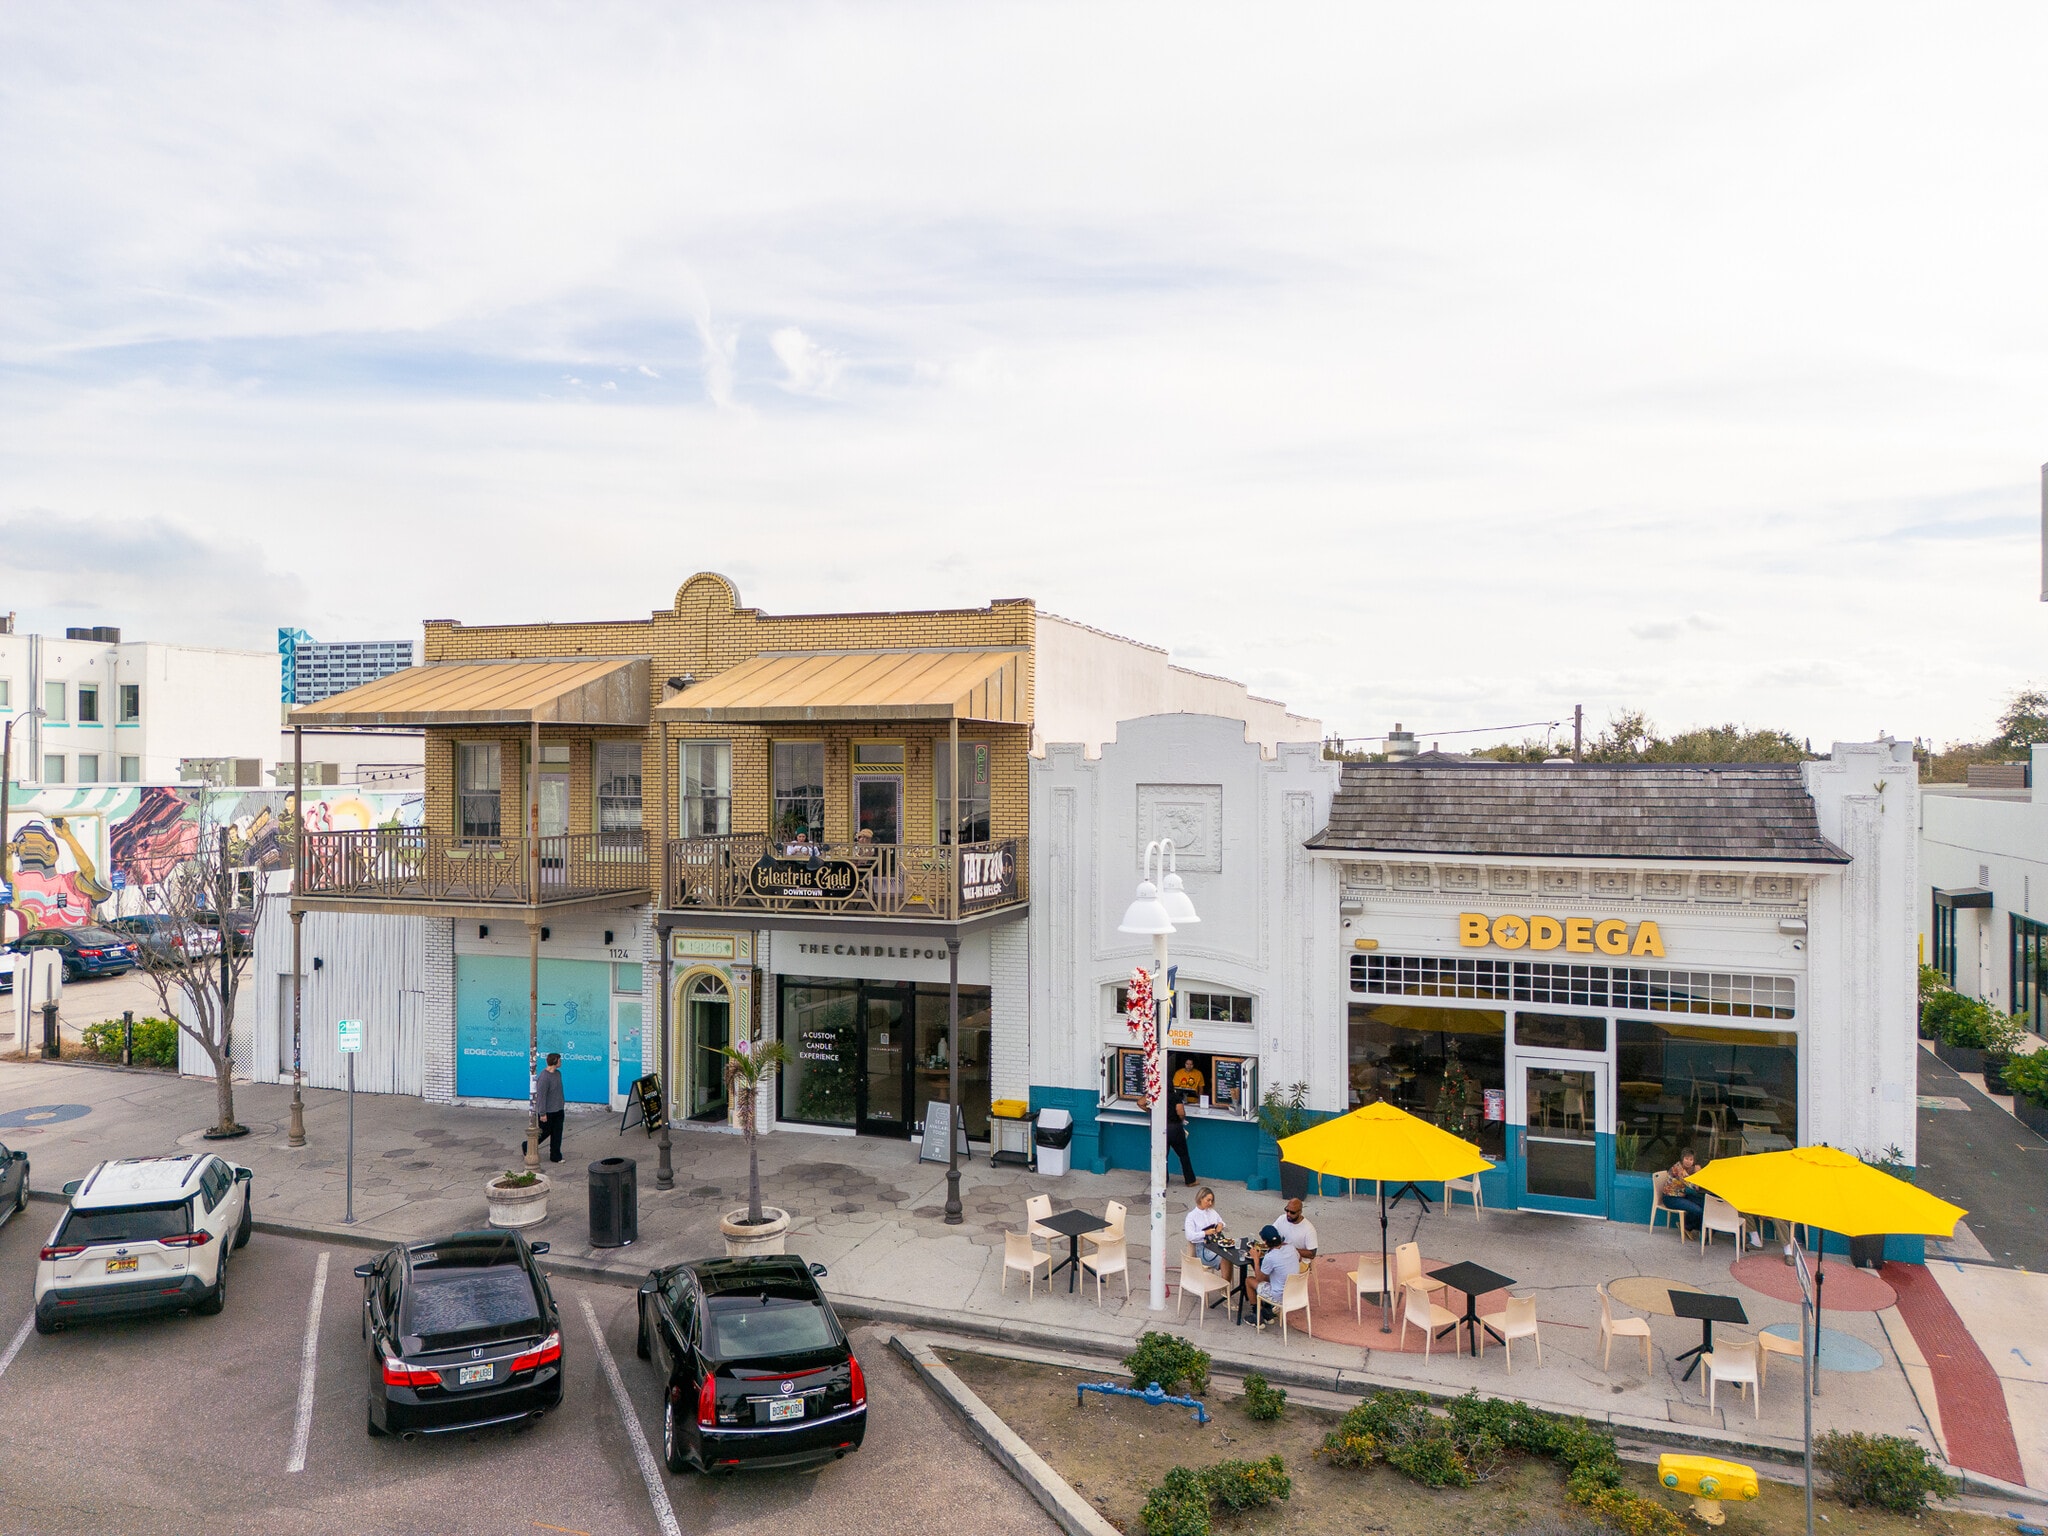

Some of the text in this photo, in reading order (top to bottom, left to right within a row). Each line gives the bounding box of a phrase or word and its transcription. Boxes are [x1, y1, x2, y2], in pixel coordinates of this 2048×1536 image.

[977, 746, 986, 782] OPEN
[757, 865, 851, 889] Electric Gold
[783, 888, 823, 896] DOWNTOWN
[1459, 912, 1667, 958] BODEGA
[609, 948, 629, 959] 1124
[798, 943, 947, 961] THE CANDLE POU
[802, 1031, 836, 1040] A CUSTOM
[1168, 1029, 1194, 1039] ORDER
[806, 1041, 832, 1050] CANDLE
[1172, 1038, 1191, 1047] HERE
[799, 1052, 839, 1062] EXPERIENCE
